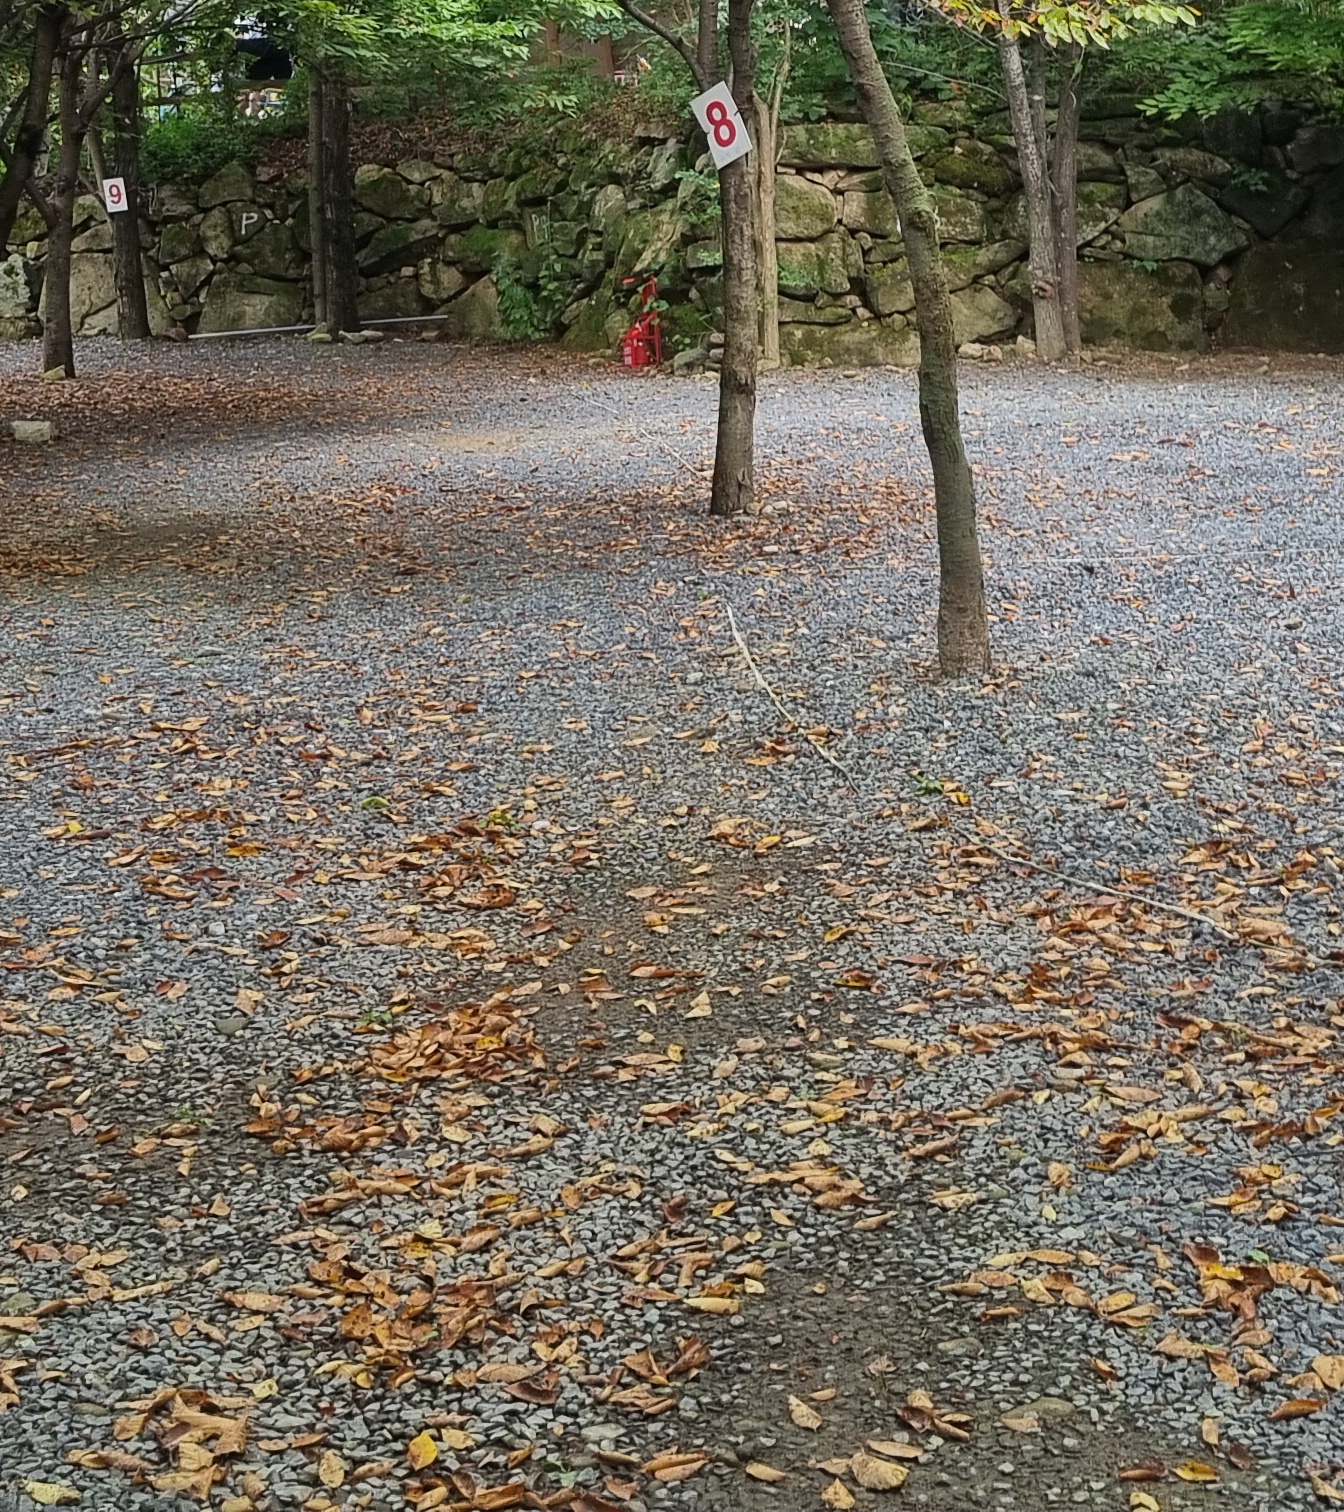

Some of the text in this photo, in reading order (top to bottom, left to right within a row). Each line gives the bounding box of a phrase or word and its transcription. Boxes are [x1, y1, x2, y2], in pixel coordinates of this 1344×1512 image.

[705, 100, 737, 148] 8
[108, 184, 122, 205] 9
[241, 213, 258, 235] P
